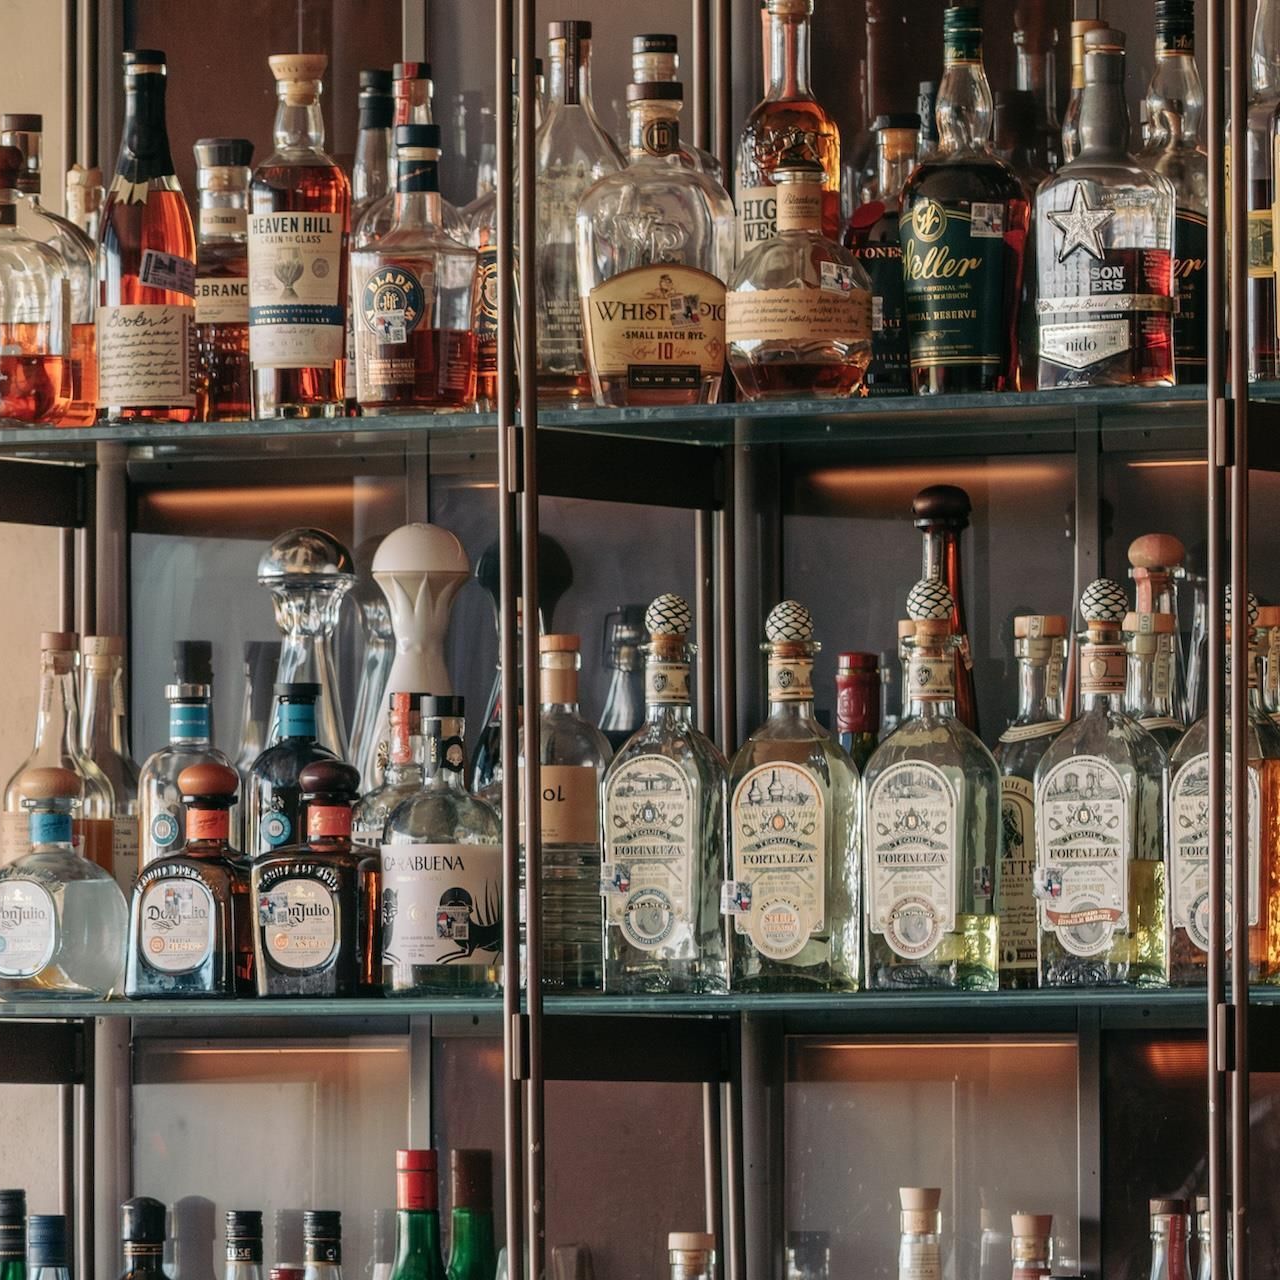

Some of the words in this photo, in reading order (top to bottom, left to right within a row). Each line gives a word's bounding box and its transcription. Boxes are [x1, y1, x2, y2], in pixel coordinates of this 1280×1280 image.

[252, 217, 300, 235] HEAVEN
[303, 217, 334, 234] HILL
[295, 235, 322, 245] GLASS
[903, 238, 984, 282] Weller
[367, 272, 415, 294] BLADE
[106, 309, 175, 329] Booker's
[933, 309, 977, 320] RESERVE
[624, 331, 655, 341] SMALL
[657, 331, 686, 341] BATCH
[687, 331, 704, 341] RYE
[657, 342, 674, 360] 10
[1065, 337, 1098, 353] nido
[742, 853, 816, 866] FORTALEZA
[877, 853, 948, 865] FORTALEZA
[1049, 847, 1121, 859] FORTALEZA
[383, 856, 465, 872] CARABUENA
[760, 898, 801, 913] BLANCO
[298, 902, 330, 925] Julio
[1057, 914, 1084, 926] SINGLE
[1085, 912, 1113, 923] BARREL
